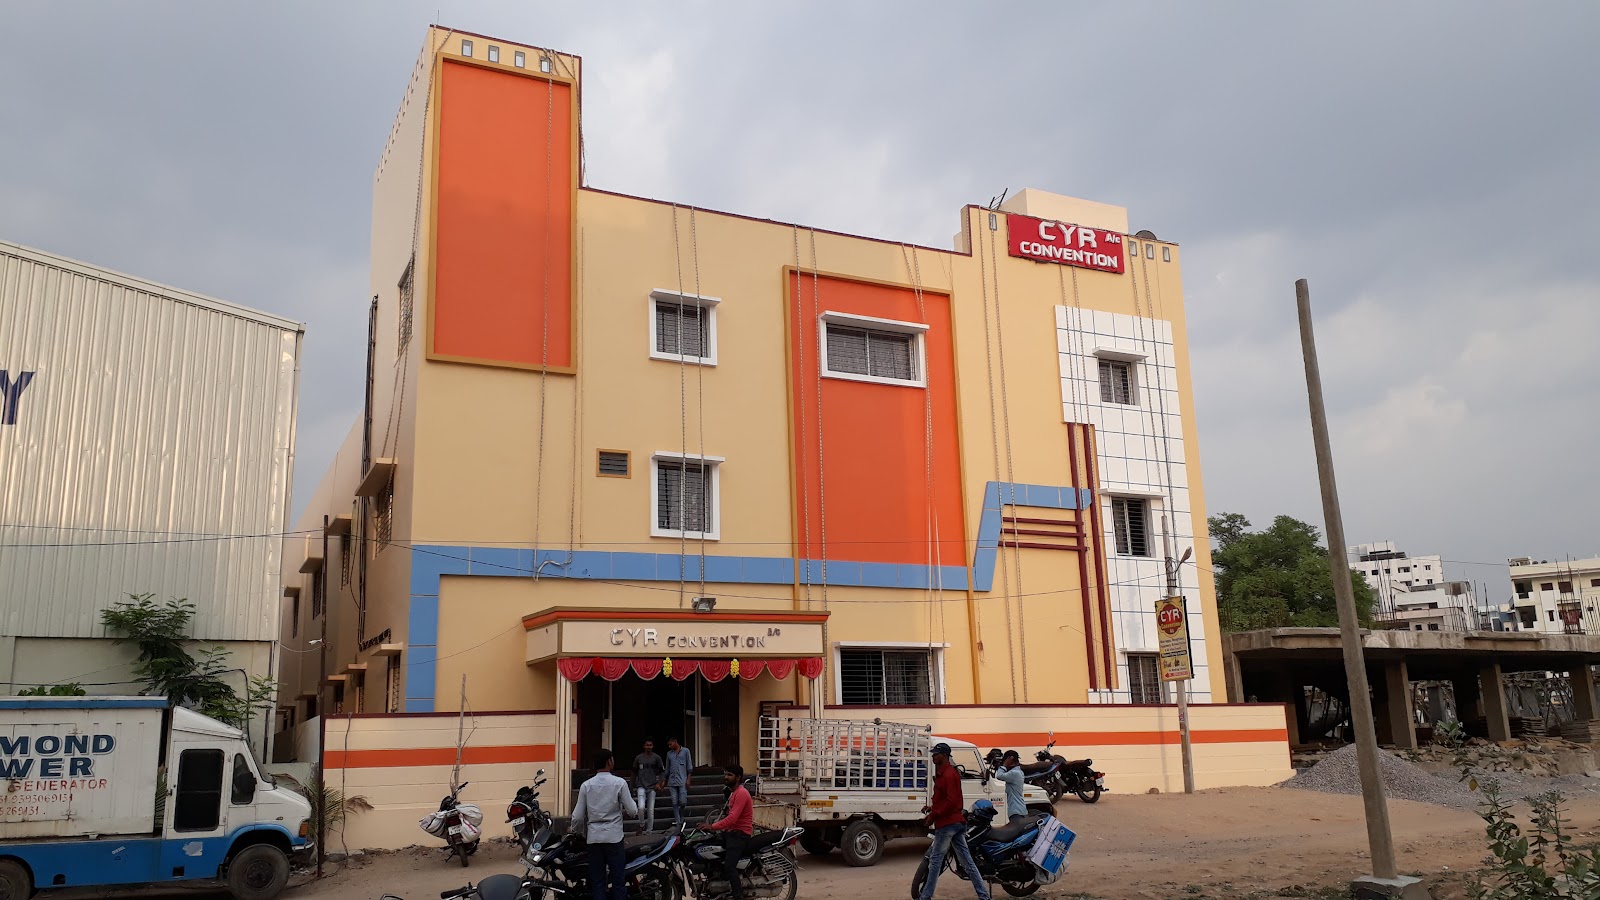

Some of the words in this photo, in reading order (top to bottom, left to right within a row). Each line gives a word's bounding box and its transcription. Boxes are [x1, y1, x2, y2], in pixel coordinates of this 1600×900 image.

[1038, 221, 1098, 249] CYR
[1105, 233, 1121, 244] A/c
[1019, 241, 1118, 269] CONVENTION
[1160, 608, 1180, 623] CYR
[610, 627, 658, 647] CYR
[667, 635, 765, 648] CONVENTION
